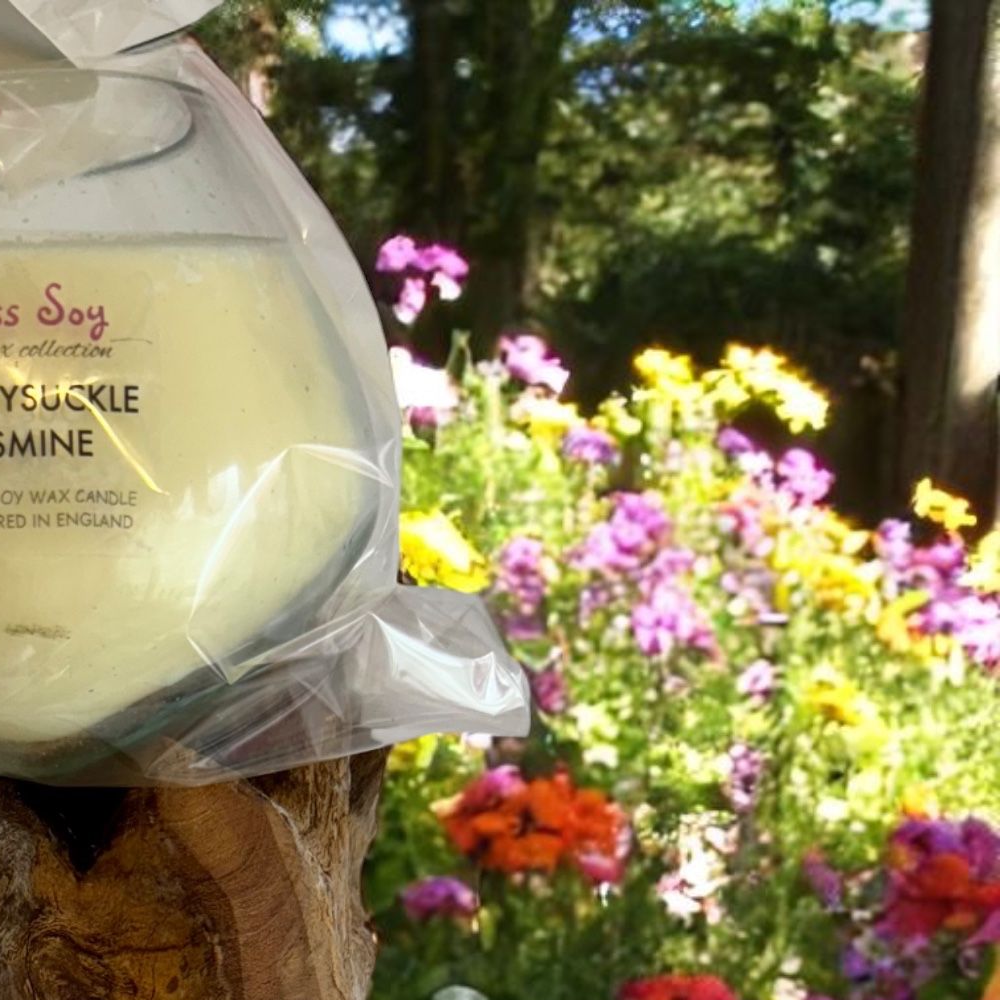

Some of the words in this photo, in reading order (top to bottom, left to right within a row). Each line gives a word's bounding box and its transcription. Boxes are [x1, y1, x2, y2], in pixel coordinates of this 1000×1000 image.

[36, 282, 109, 341] Soy
[18, 340, 113, 360] collection
[29, 489, 71, 505] WAX
[74, 489, 138, 507] CANDLE
[32, 513, 50, 529] IN
[56, 511, 134, 530] ENGLAND
